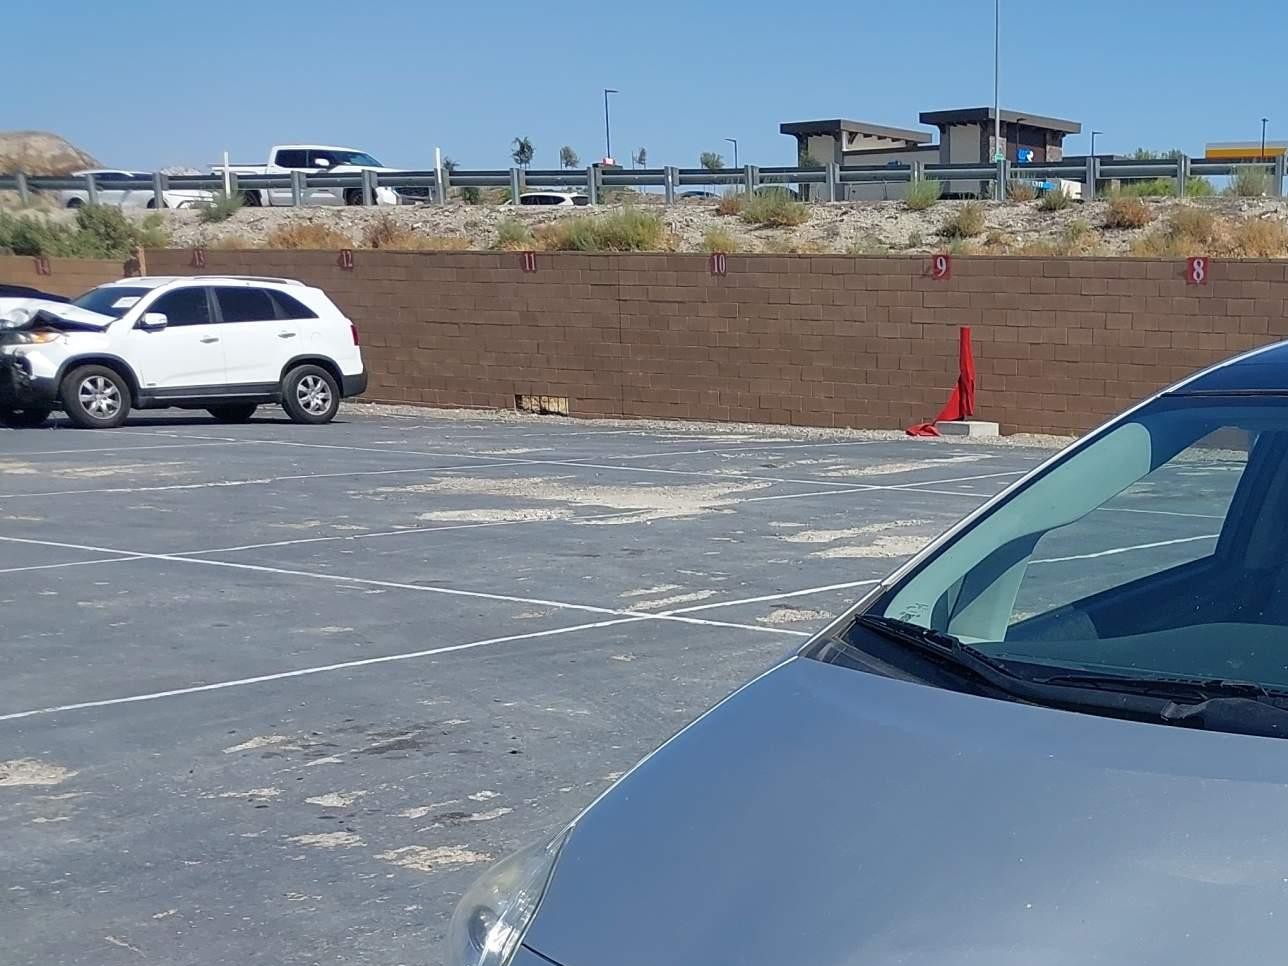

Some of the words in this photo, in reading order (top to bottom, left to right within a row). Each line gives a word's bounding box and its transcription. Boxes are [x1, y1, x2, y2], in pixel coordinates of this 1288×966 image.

[342, 250, 353, 268] 12
[524, 253, 536, 271] 11
[713, 254, 726, 273] 10
[936, 255, 947, 277] 9
[1192, 258, 1204, 282] 8
